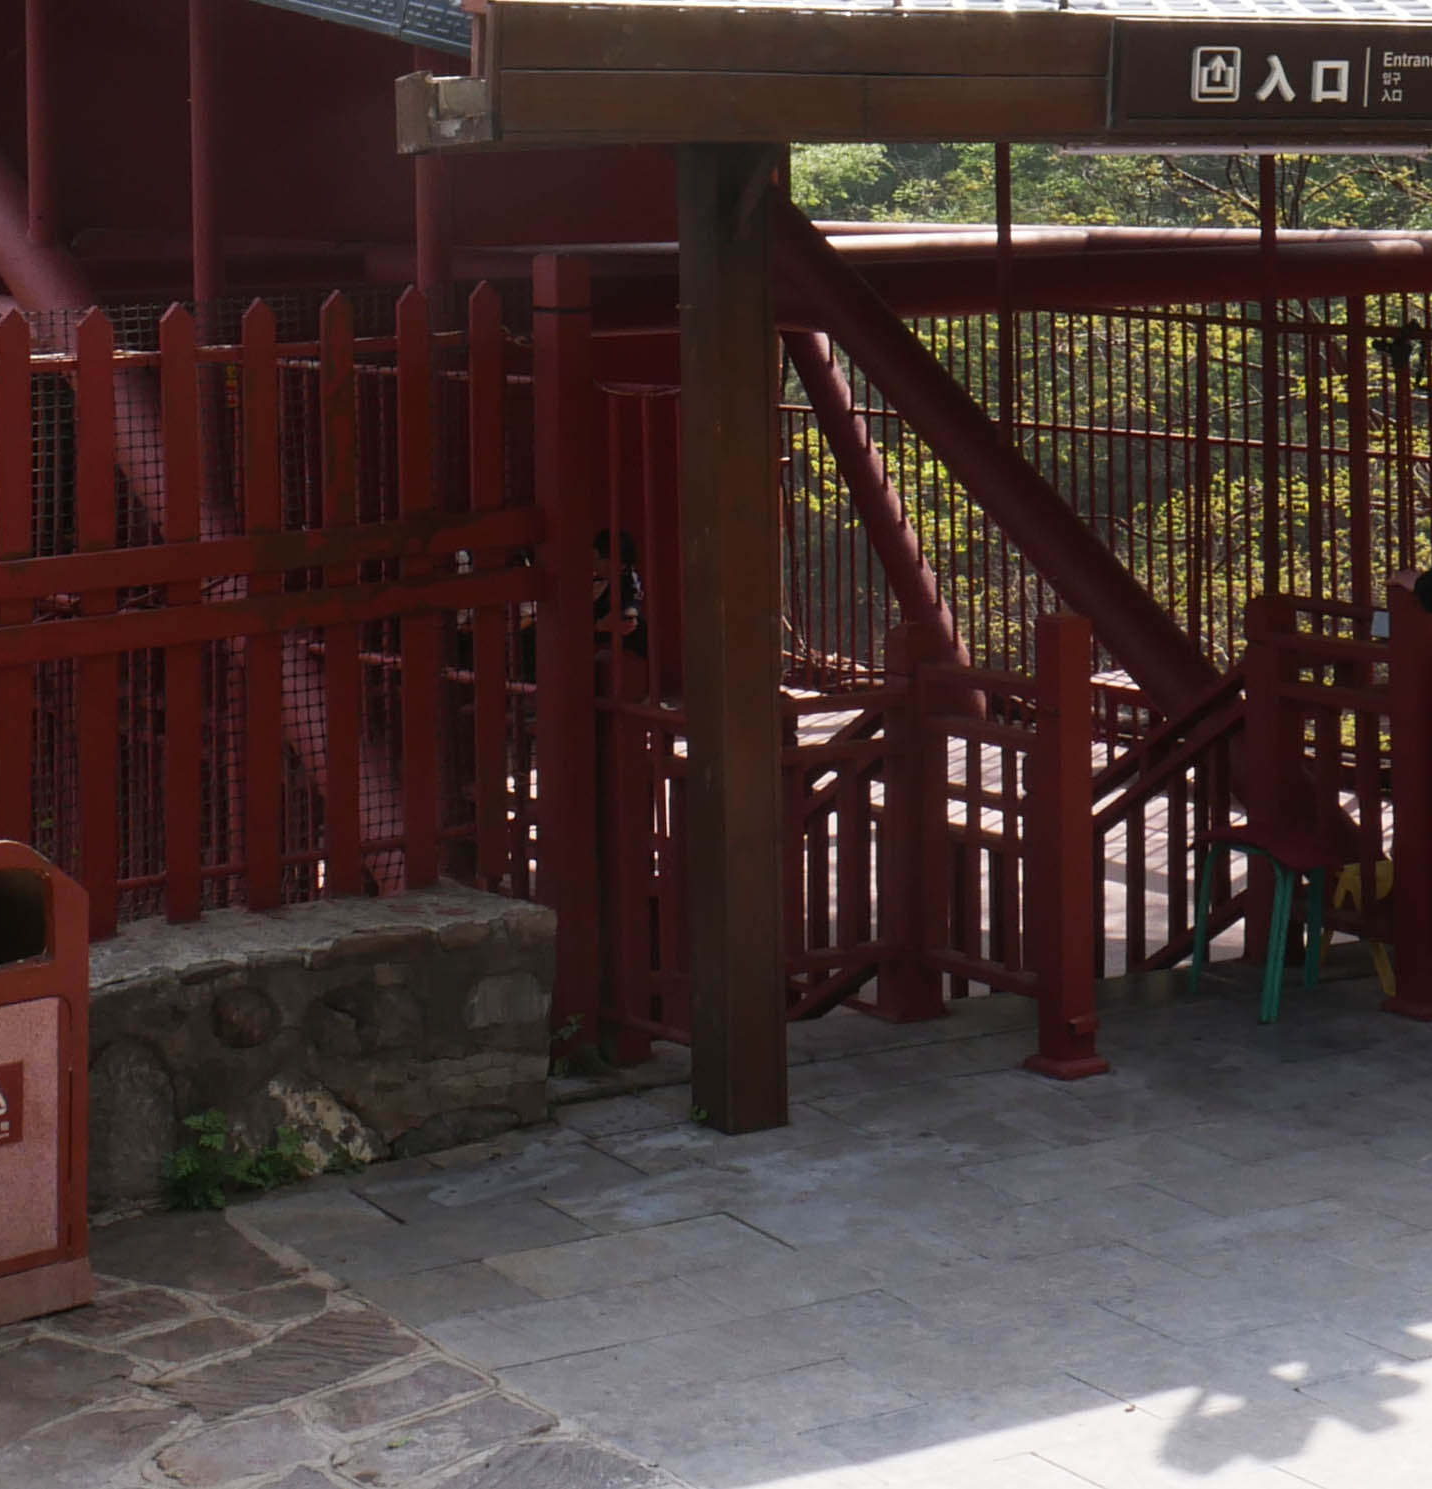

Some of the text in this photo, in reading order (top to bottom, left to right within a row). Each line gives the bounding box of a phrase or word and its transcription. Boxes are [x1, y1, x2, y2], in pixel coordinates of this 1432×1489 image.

[1256, 55, 1350, 103] 入口
[1382, 72, 1402, 86] 입구
[1381, 88, 1403, 102] 入口
